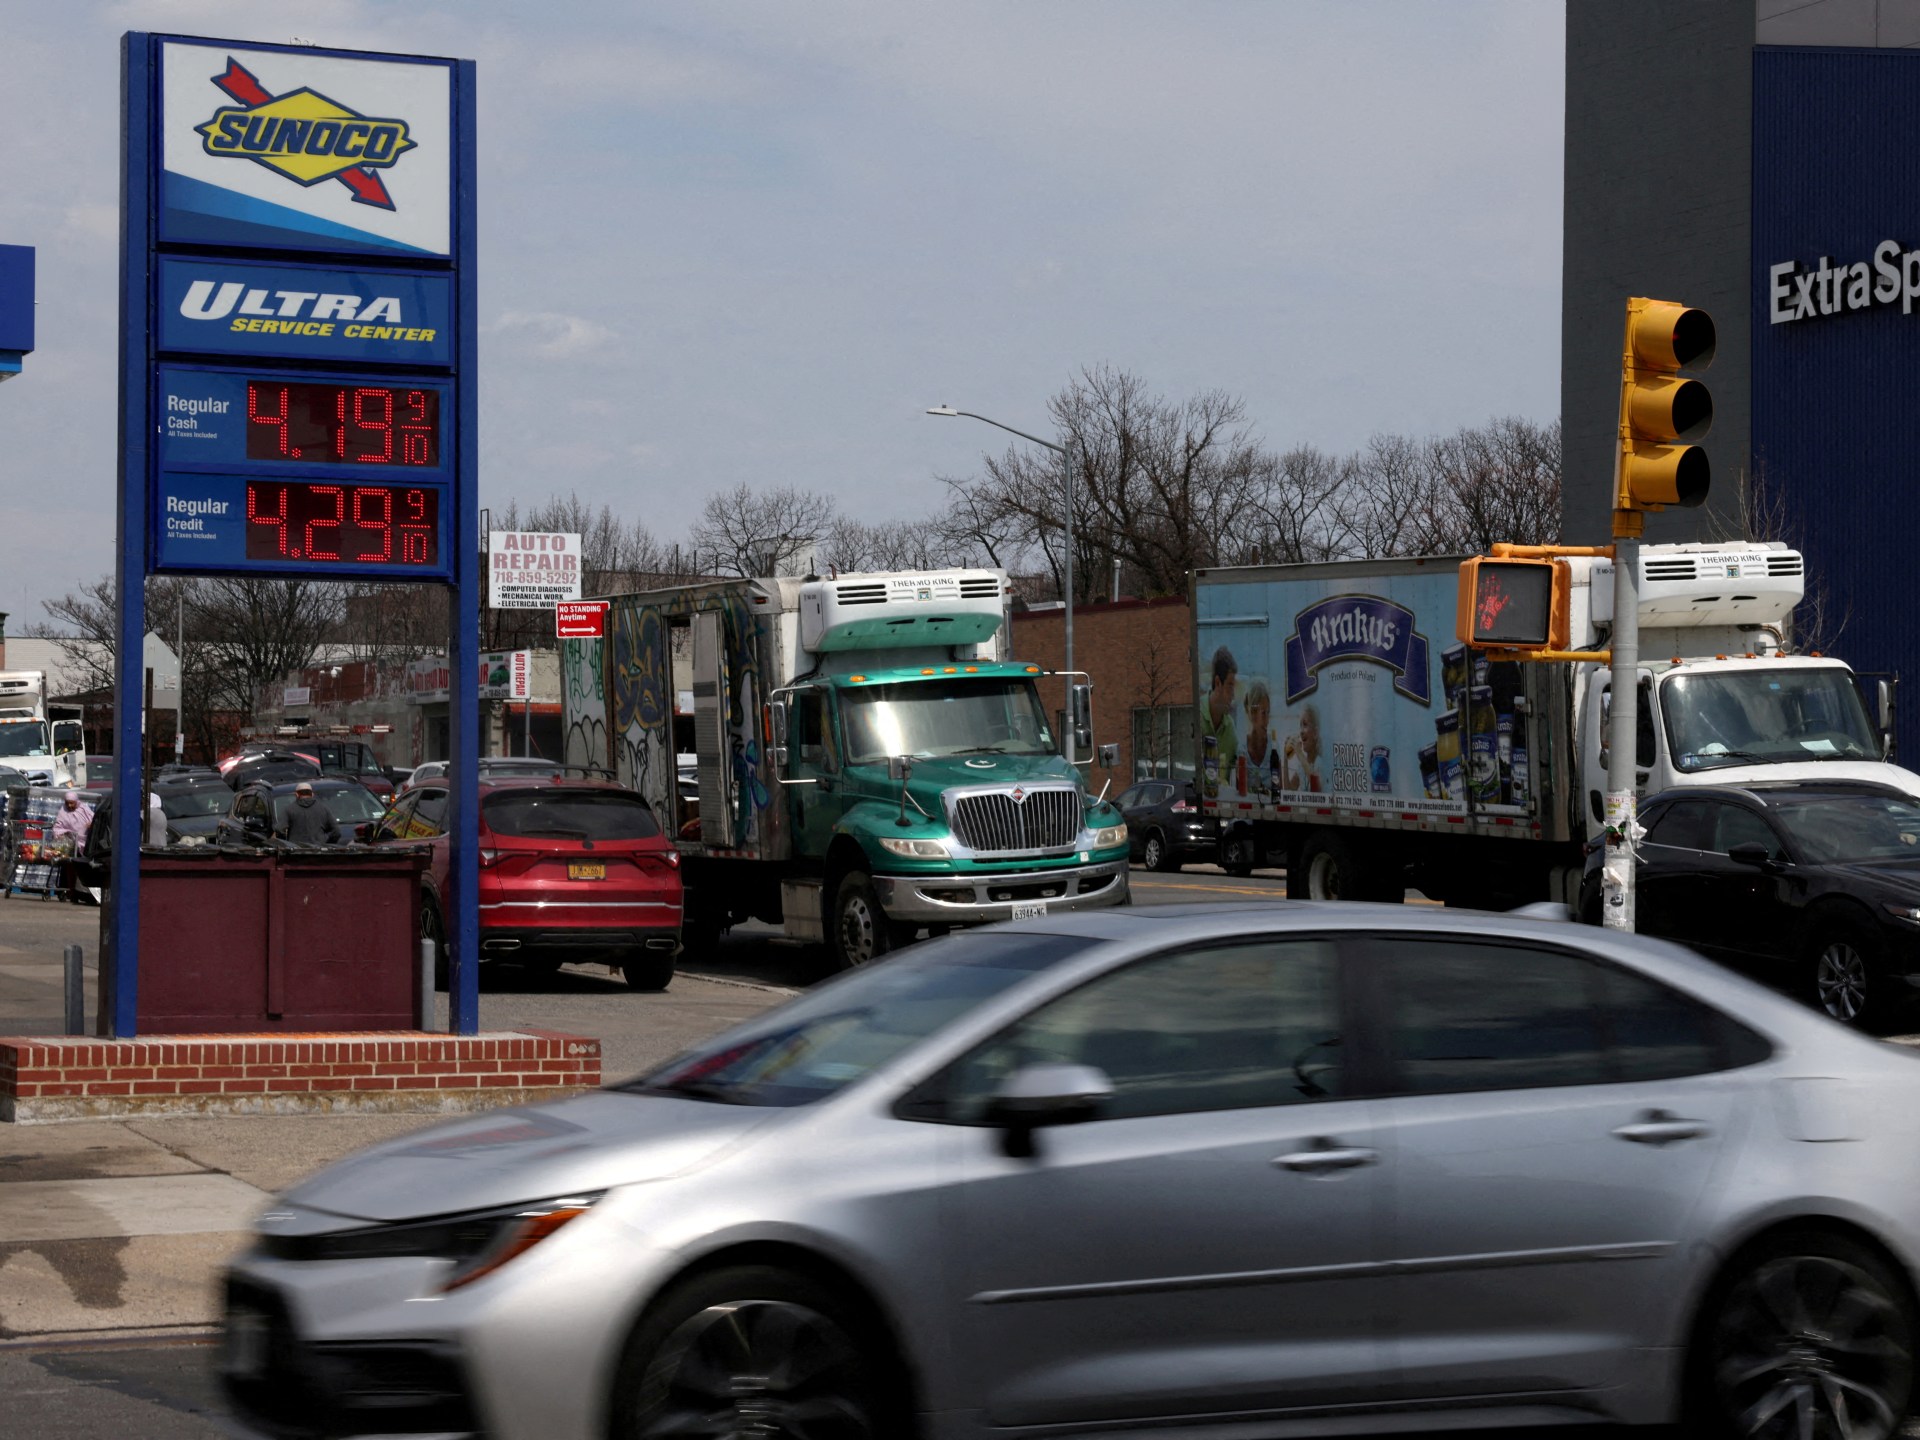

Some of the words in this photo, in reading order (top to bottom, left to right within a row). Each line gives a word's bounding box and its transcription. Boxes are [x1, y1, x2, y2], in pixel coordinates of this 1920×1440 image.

[213, 114, 399, 160] SUNOCO
[180, 280, 401, 323] ULTRA
[230, 318, 335, 336] SERVICE
[344, 324, 436, 342] CENTER
[167, 394, 230, 415] Regular
[408, 391, 425, 421] 9
[168, 416, 197, 430] Cash
[249, 386, 393, 463] 4.19
[167, 496, 229, 517] Regular
[408, 490, 424, 520] 9
[167, 517, 203, 531] Credit
[248, 486, 392, 562] 4.29
[504, 534, 566, 551] AUTO
[493, 553, 577, 571] REPAIR
[1701, 556, 1739, 564] THERMO
[494, 571, 577, 585] 718-859-5292
[892, 580, 931, 588] THERMO
[932, 578, 954, 586] KING
[501, 585, 537, 593] COMPUTER
[501, 592, 543, 600] MECHANICAL
[501, 600, 538, 608] ELECTRICAL
[559, 605, 568, 613] NO
[570, 605, 602, 613] STANDING
[559, 613, 587, 622] Anytime
[1311, 606, 1396, 653] Krakus
[515, 653, 525, 671] AUTO
[515, 672, 525, 696] REPAIR
[1331, 672, 1351, 682] Product
[1358, 671, 1376, 682] Poland
[1333, 743, 1364, 767] PRIME
[1332, 768, 1367, 792] CHOICE
